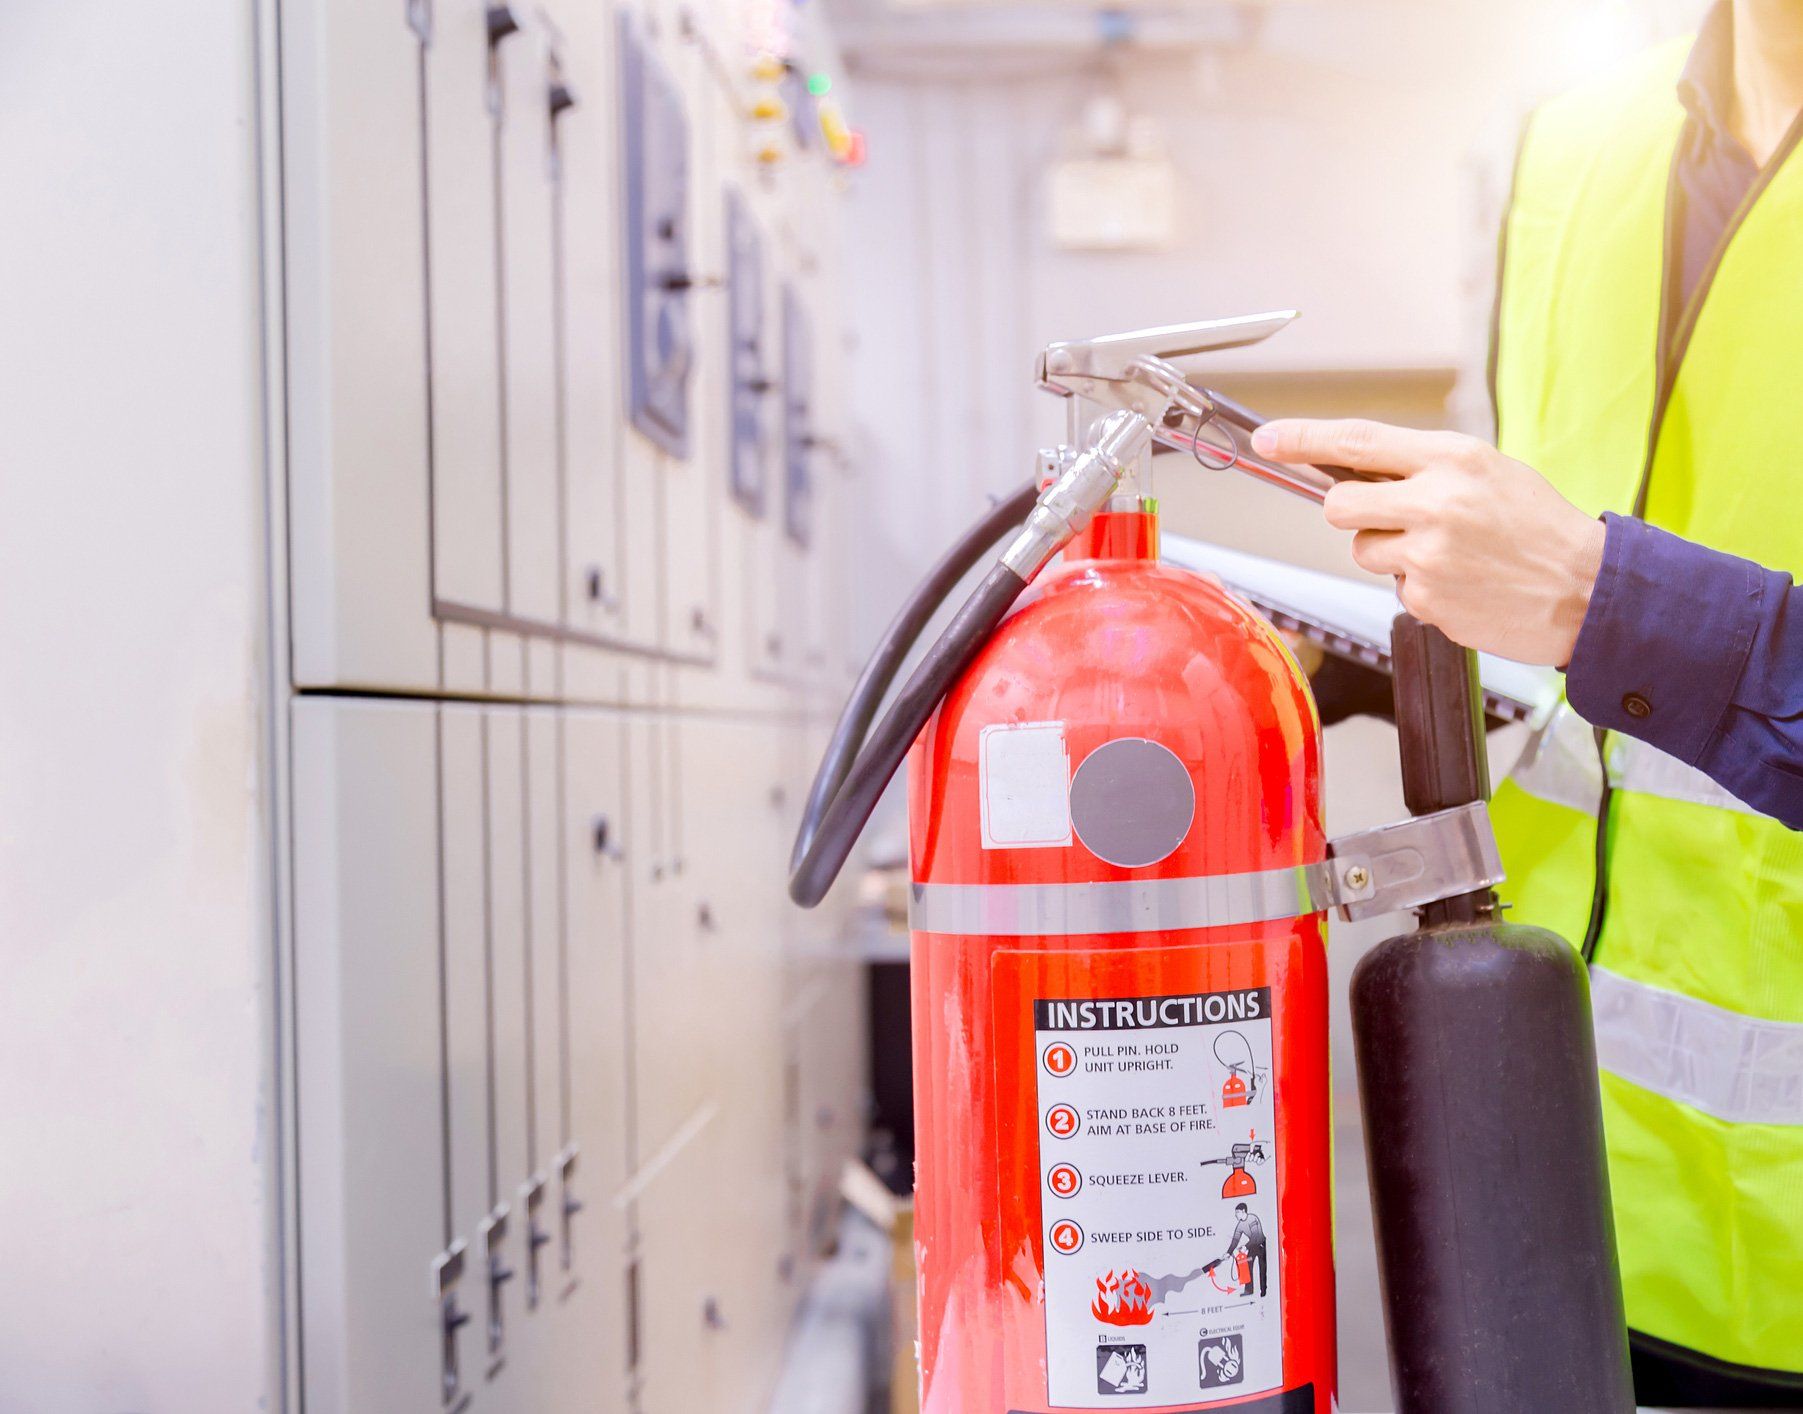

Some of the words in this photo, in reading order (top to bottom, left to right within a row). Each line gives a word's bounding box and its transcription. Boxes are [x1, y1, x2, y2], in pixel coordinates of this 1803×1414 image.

[1048, 991, 1260, 1029] INSTRUCTIONS
[1084, 1046, 1114, 1057] PULL
[1117, 1045, 1141, 1057] PIN.
[1145, 1043, 1179, 1055] HOLD
[1052, 1050, 1065, 1069] 1
[1084, 1061, 1114, 1073] UNIT
[1118, 1059, 1173, 1072] UPRIGHT.
[1086, 1108, 1128, 1120] STAND
[1132, 1106, 1164, 1119] BACK
[1168, 1106, 1176, 1117] 8
[1179, 1104, 1208, 1116] FEET.
[1054, 1112, 1069, 1131] 2
[1087, 1124, 1112, 1136] AIM
[1116, 1123, 1131, 1135] AT
[1135, 1122, 1166, 1134] BASE
[1170, 1120, 1186, 1132] OF
[1189, 1118, 1216, 1131] FIRE.
[1056, 1171, 1072, 1191] 3
[1089, 1174, 1144, 1187] SQUEEZE
[1148, 1172, 1188, 1184] LEVER.
[1057, 1227, 1074, 1247] 4
[1091, 1232, 1132, 1244] SWEEP
[1136, 1230, 1163, 1242] SIDE
[1166, 1229, 1184, 1241] TO
[1188, 1226, 1216, 1239] SIDE.
[1207, 1305, 1223, 1315] FEET
